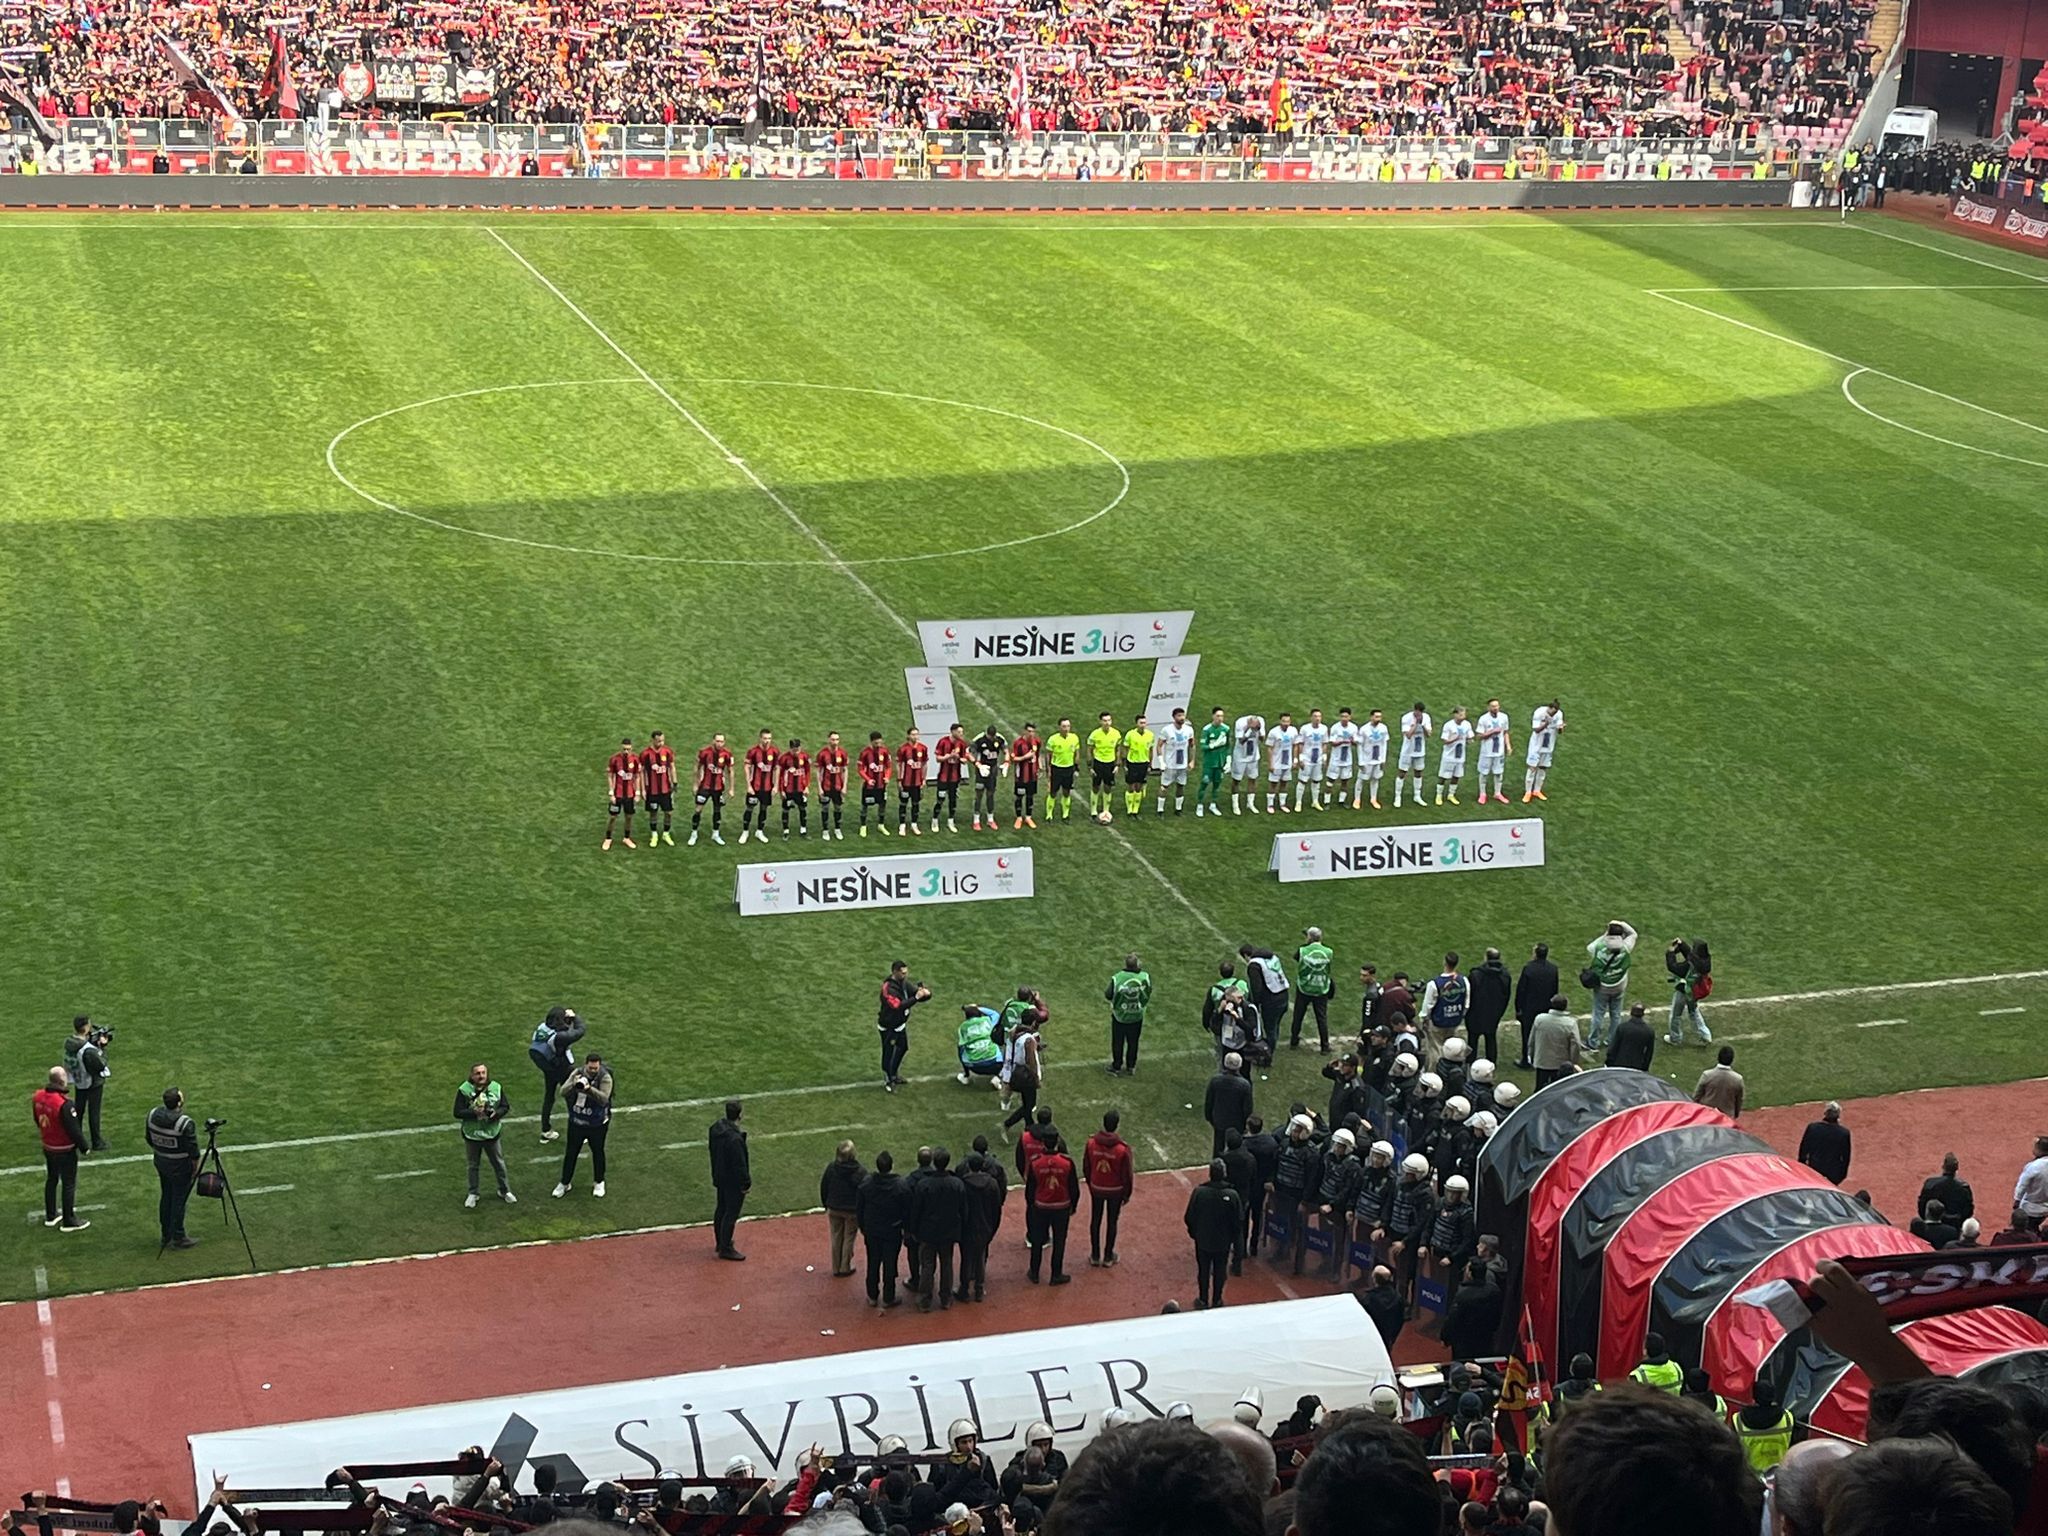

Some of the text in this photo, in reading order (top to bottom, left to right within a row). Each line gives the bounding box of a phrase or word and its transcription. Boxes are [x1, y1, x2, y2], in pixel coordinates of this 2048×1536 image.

[974, 625, 1076, 659] NESİNE
[1331, 835, 1433, 872] NESİNE
[797, 865, 912, 905] NESİNE
[614, 1357, 1166, 1480] SİVRİLER
